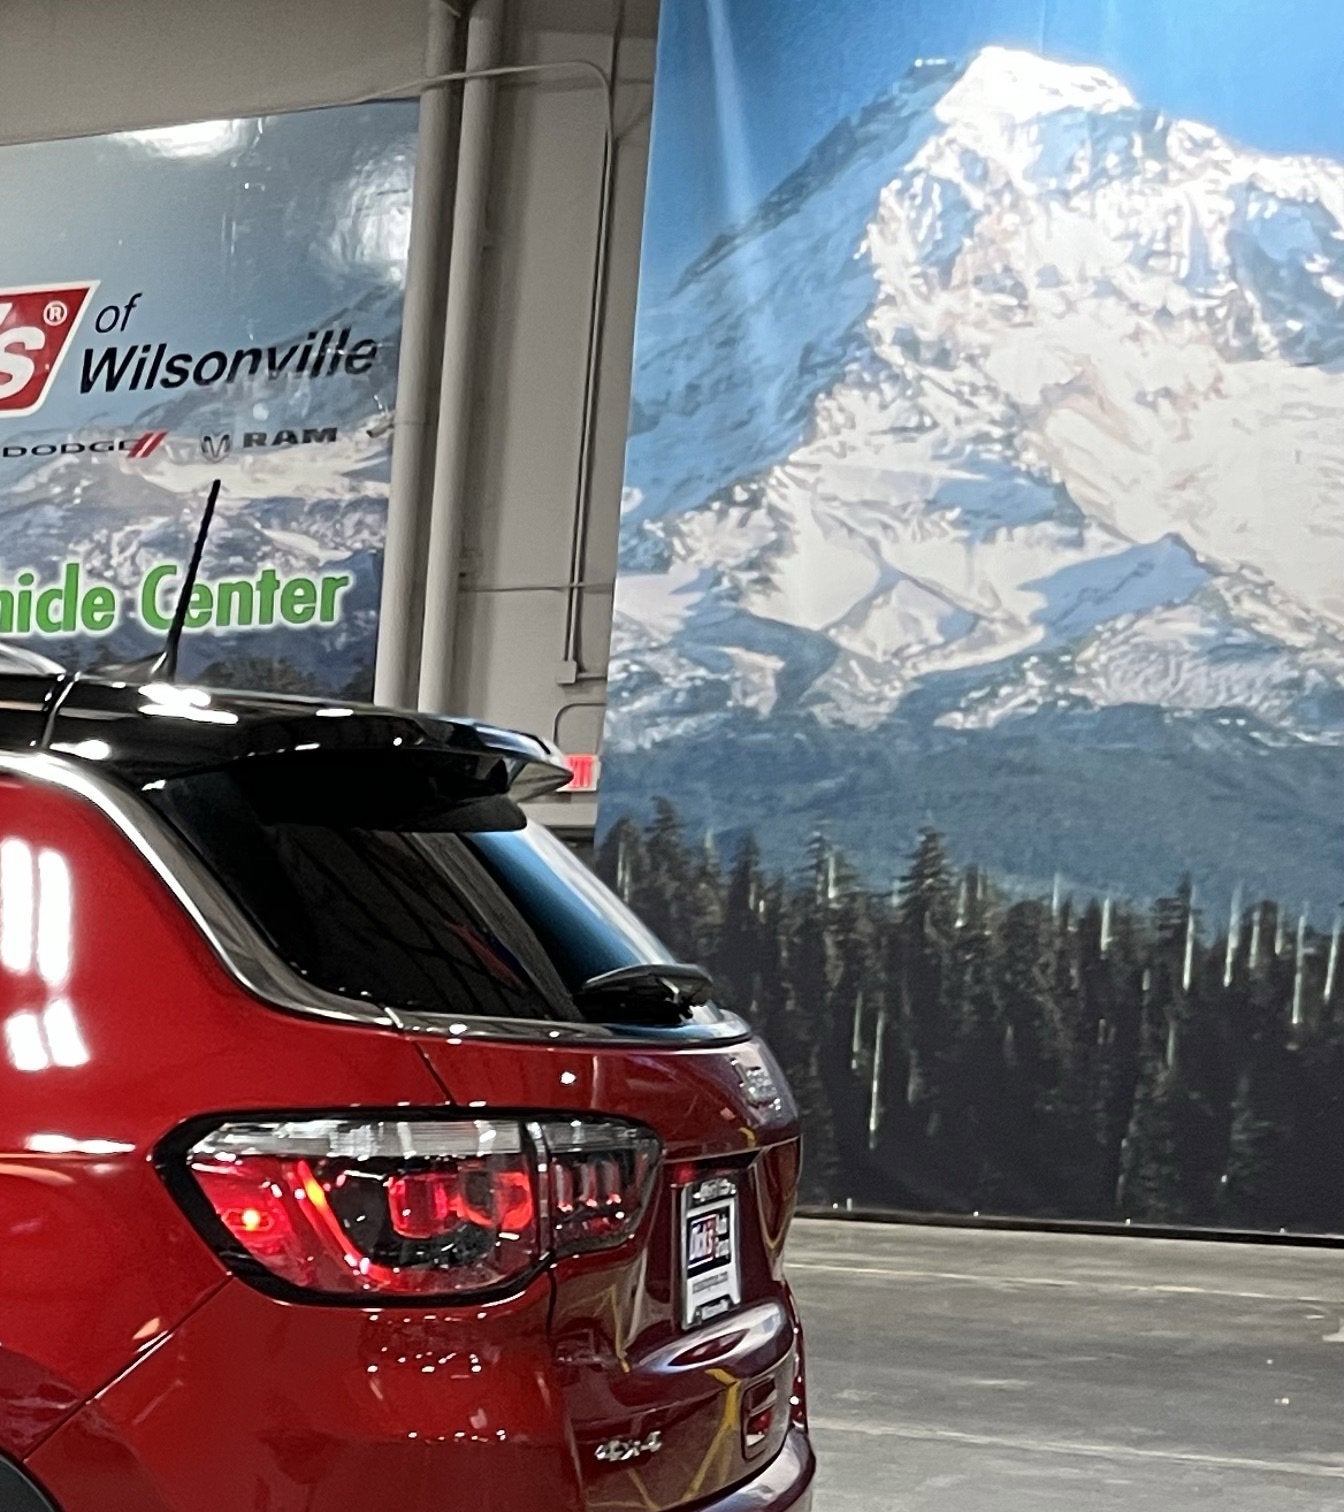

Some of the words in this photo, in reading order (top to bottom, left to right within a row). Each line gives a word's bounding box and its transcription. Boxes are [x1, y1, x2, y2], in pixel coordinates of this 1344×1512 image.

[95, 292, 143, 333] of
[79, 327, 378, 395] Wilsonville
[242, 427, 339, 448] RAM
[141, 565, 350, 630] Center
